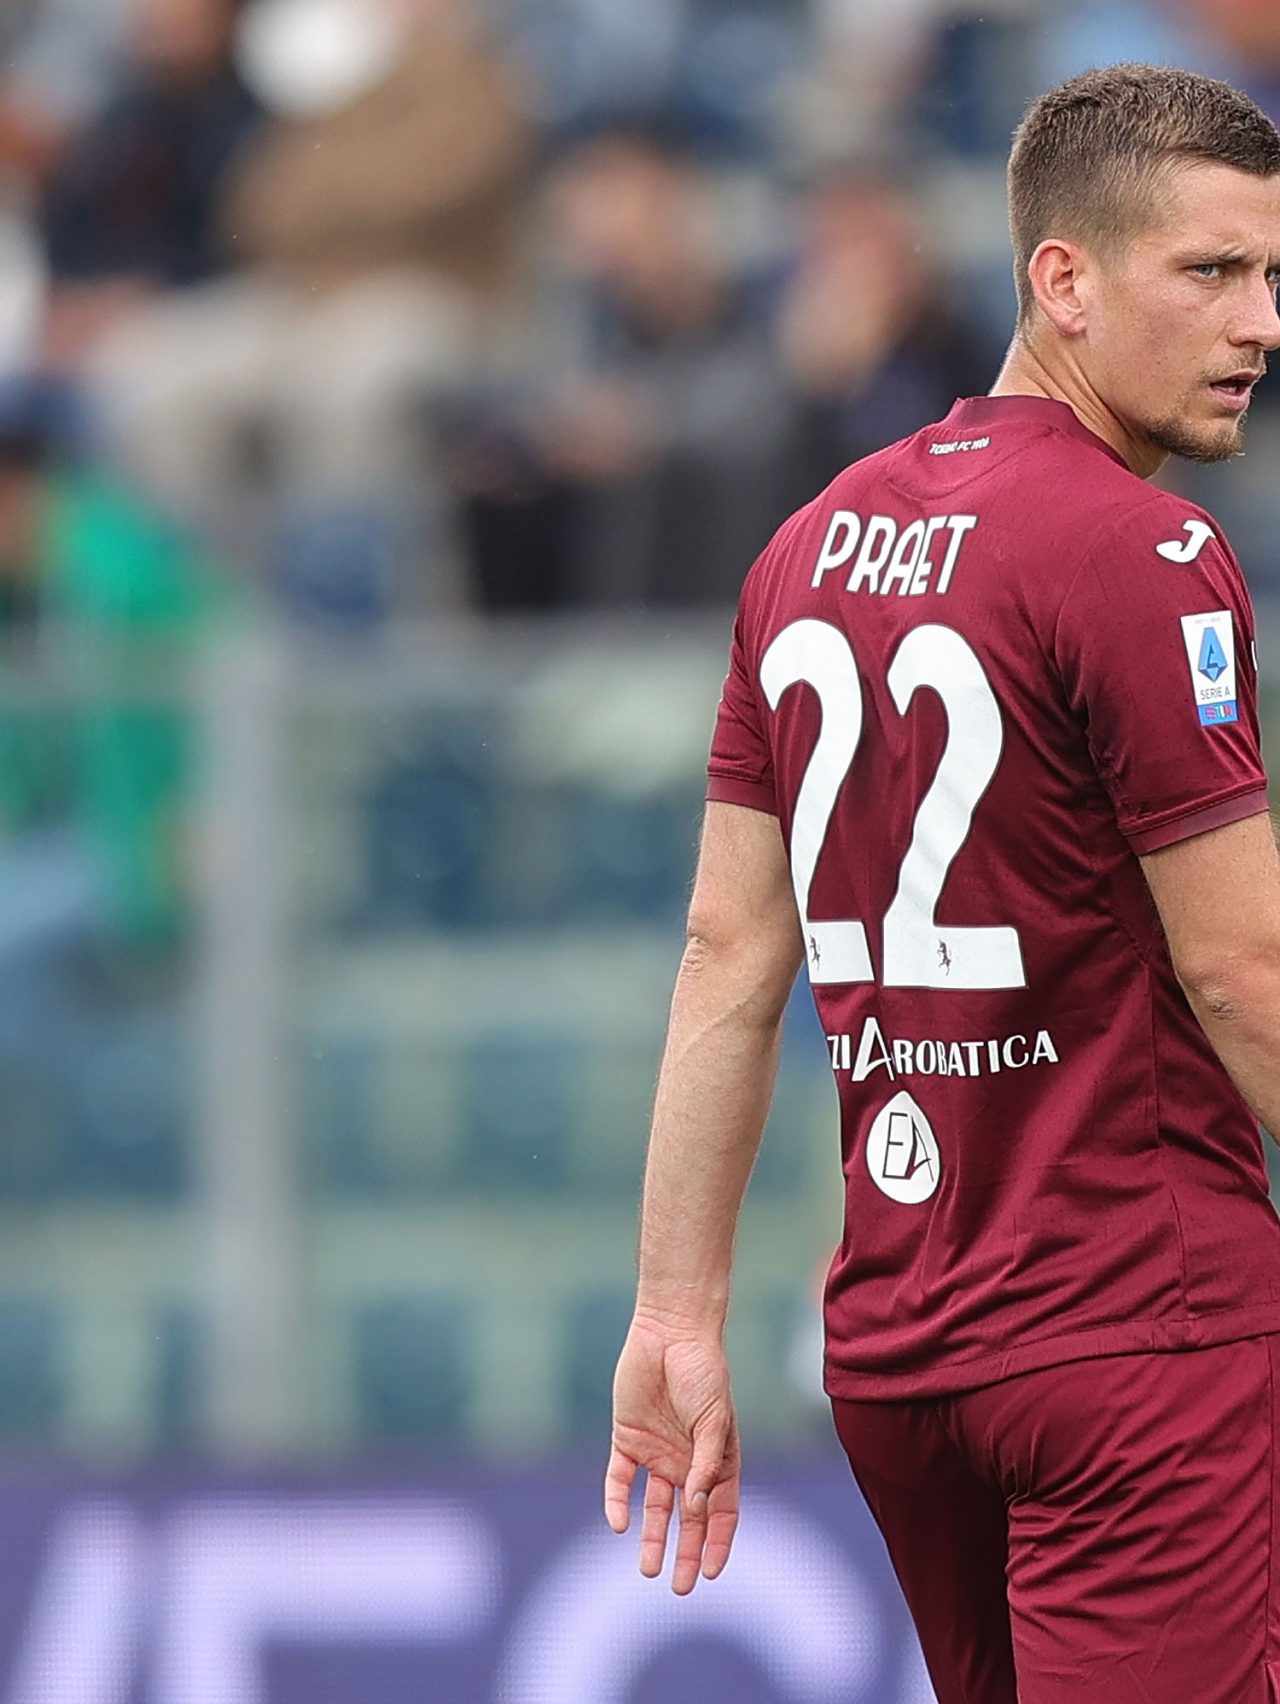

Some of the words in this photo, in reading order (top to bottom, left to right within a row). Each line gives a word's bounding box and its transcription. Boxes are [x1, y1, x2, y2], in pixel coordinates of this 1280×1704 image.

[810, 510, 978, 596] PRAET
[1200, 688, 1223, 700] SERIE
[1224, 686, 1231, 697] A
[759, 618, 1027, 989] 22
